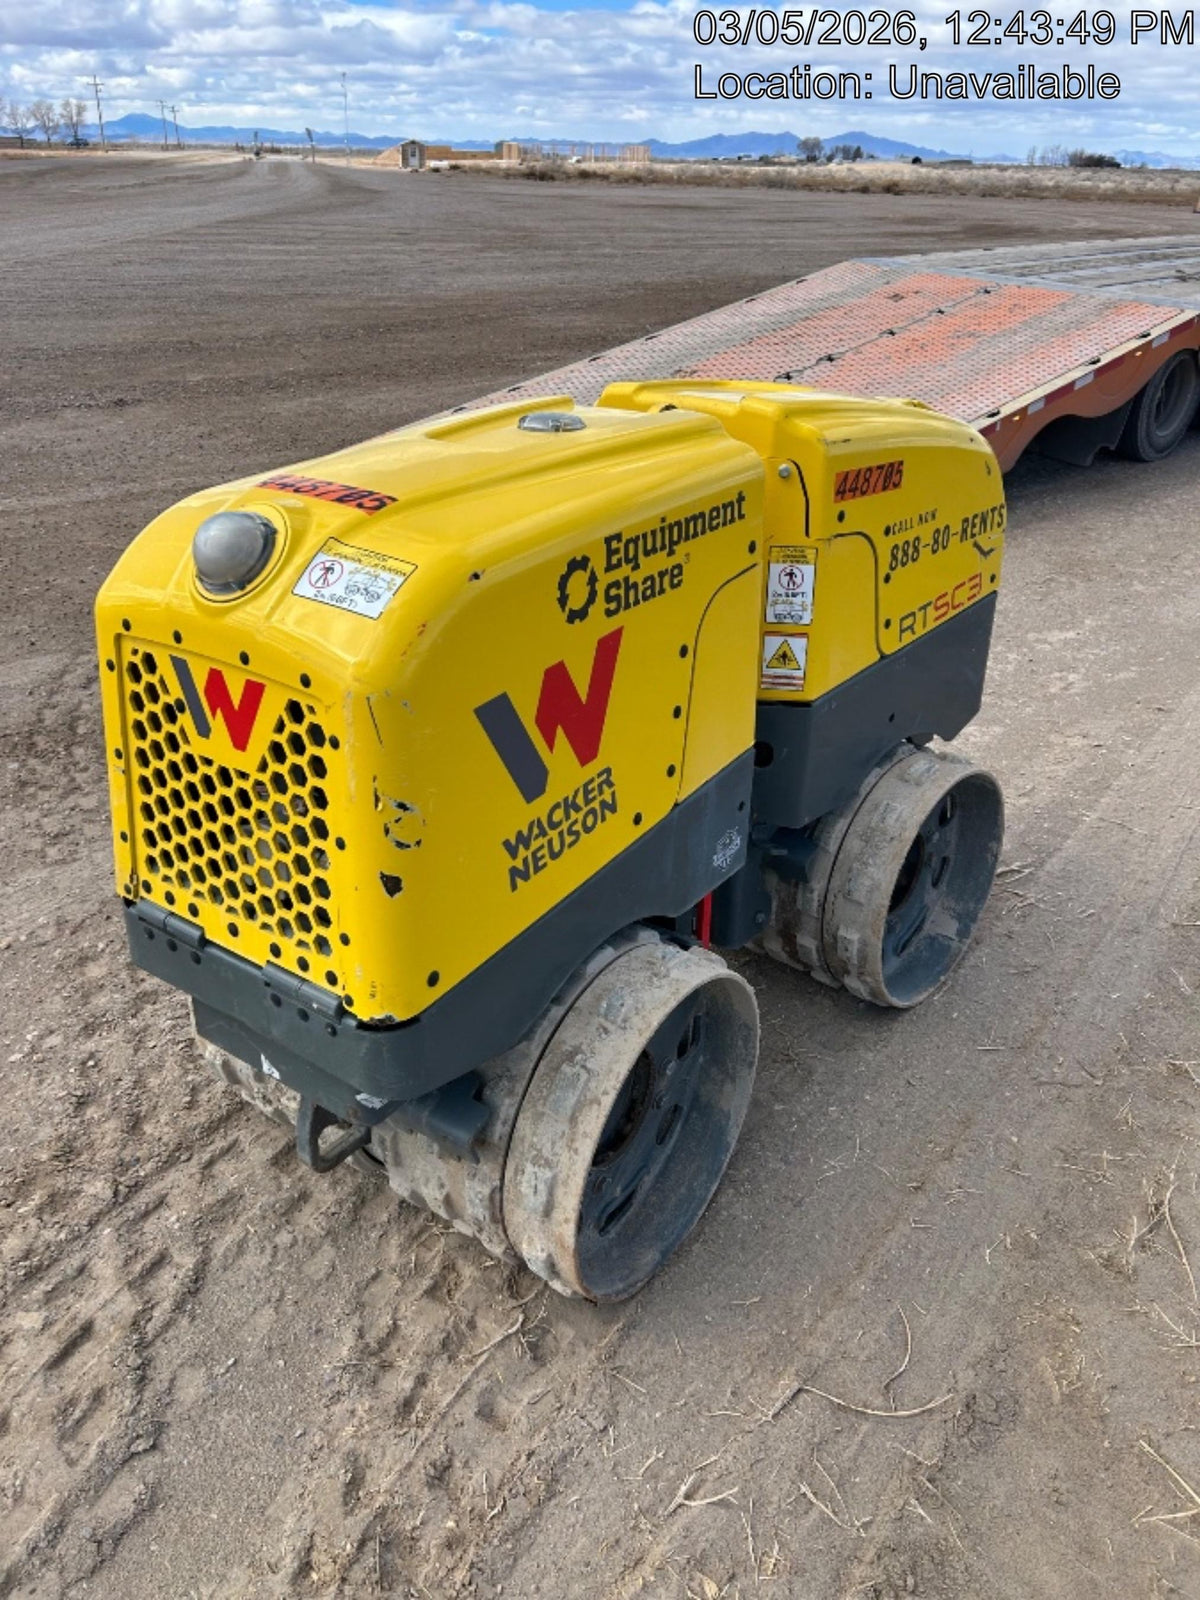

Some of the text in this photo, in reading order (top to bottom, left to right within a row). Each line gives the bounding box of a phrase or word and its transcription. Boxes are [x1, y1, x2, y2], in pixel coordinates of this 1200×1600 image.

[835, 460, 904, 500] 448705
[604, 490, 746, 574] Equipment
[889, 503, 1006, 572] 888-80-RENTS
[891, 517, 915, 535] CALL
[604, 561, 683, 618] Share
[502, 766, 616, 860] WACKER
[508, 789, 618, 893] NEUSON
